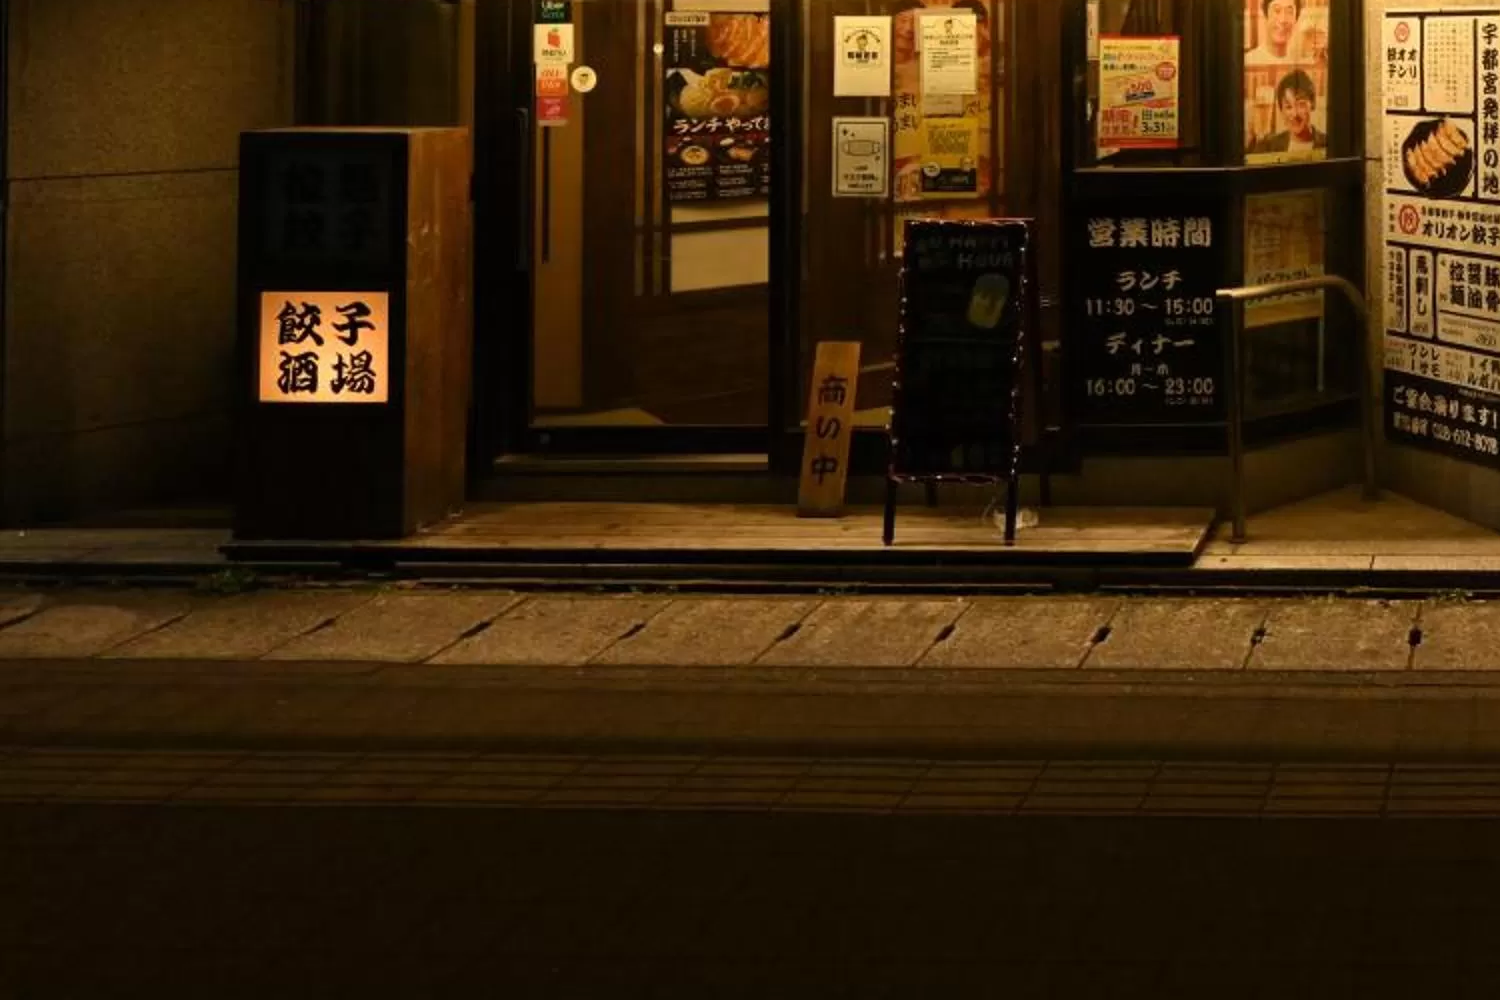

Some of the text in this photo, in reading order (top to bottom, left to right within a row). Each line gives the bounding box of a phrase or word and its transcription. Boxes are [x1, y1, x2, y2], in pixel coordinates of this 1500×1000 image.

[1481, 22, 1500, 195] 宇都宮発祥の地
[1087, 216, 1212, 248] 営業時間
[1115, 271, 1184, 291] ランチ
[1085, 298, 1135, 315] 11:30
[1164, 297, 1213, 315] 15:00
[276, 301, 376, 346] 餃子
[1105, 331, 1196, 356] ディナー
[276, 350, 376, 394] 酒場
[1085, 379, 1136, 396] 16:00
[1164, 378, 1214, 396] 23:00
[811, 371, 847, 486] 商い中
